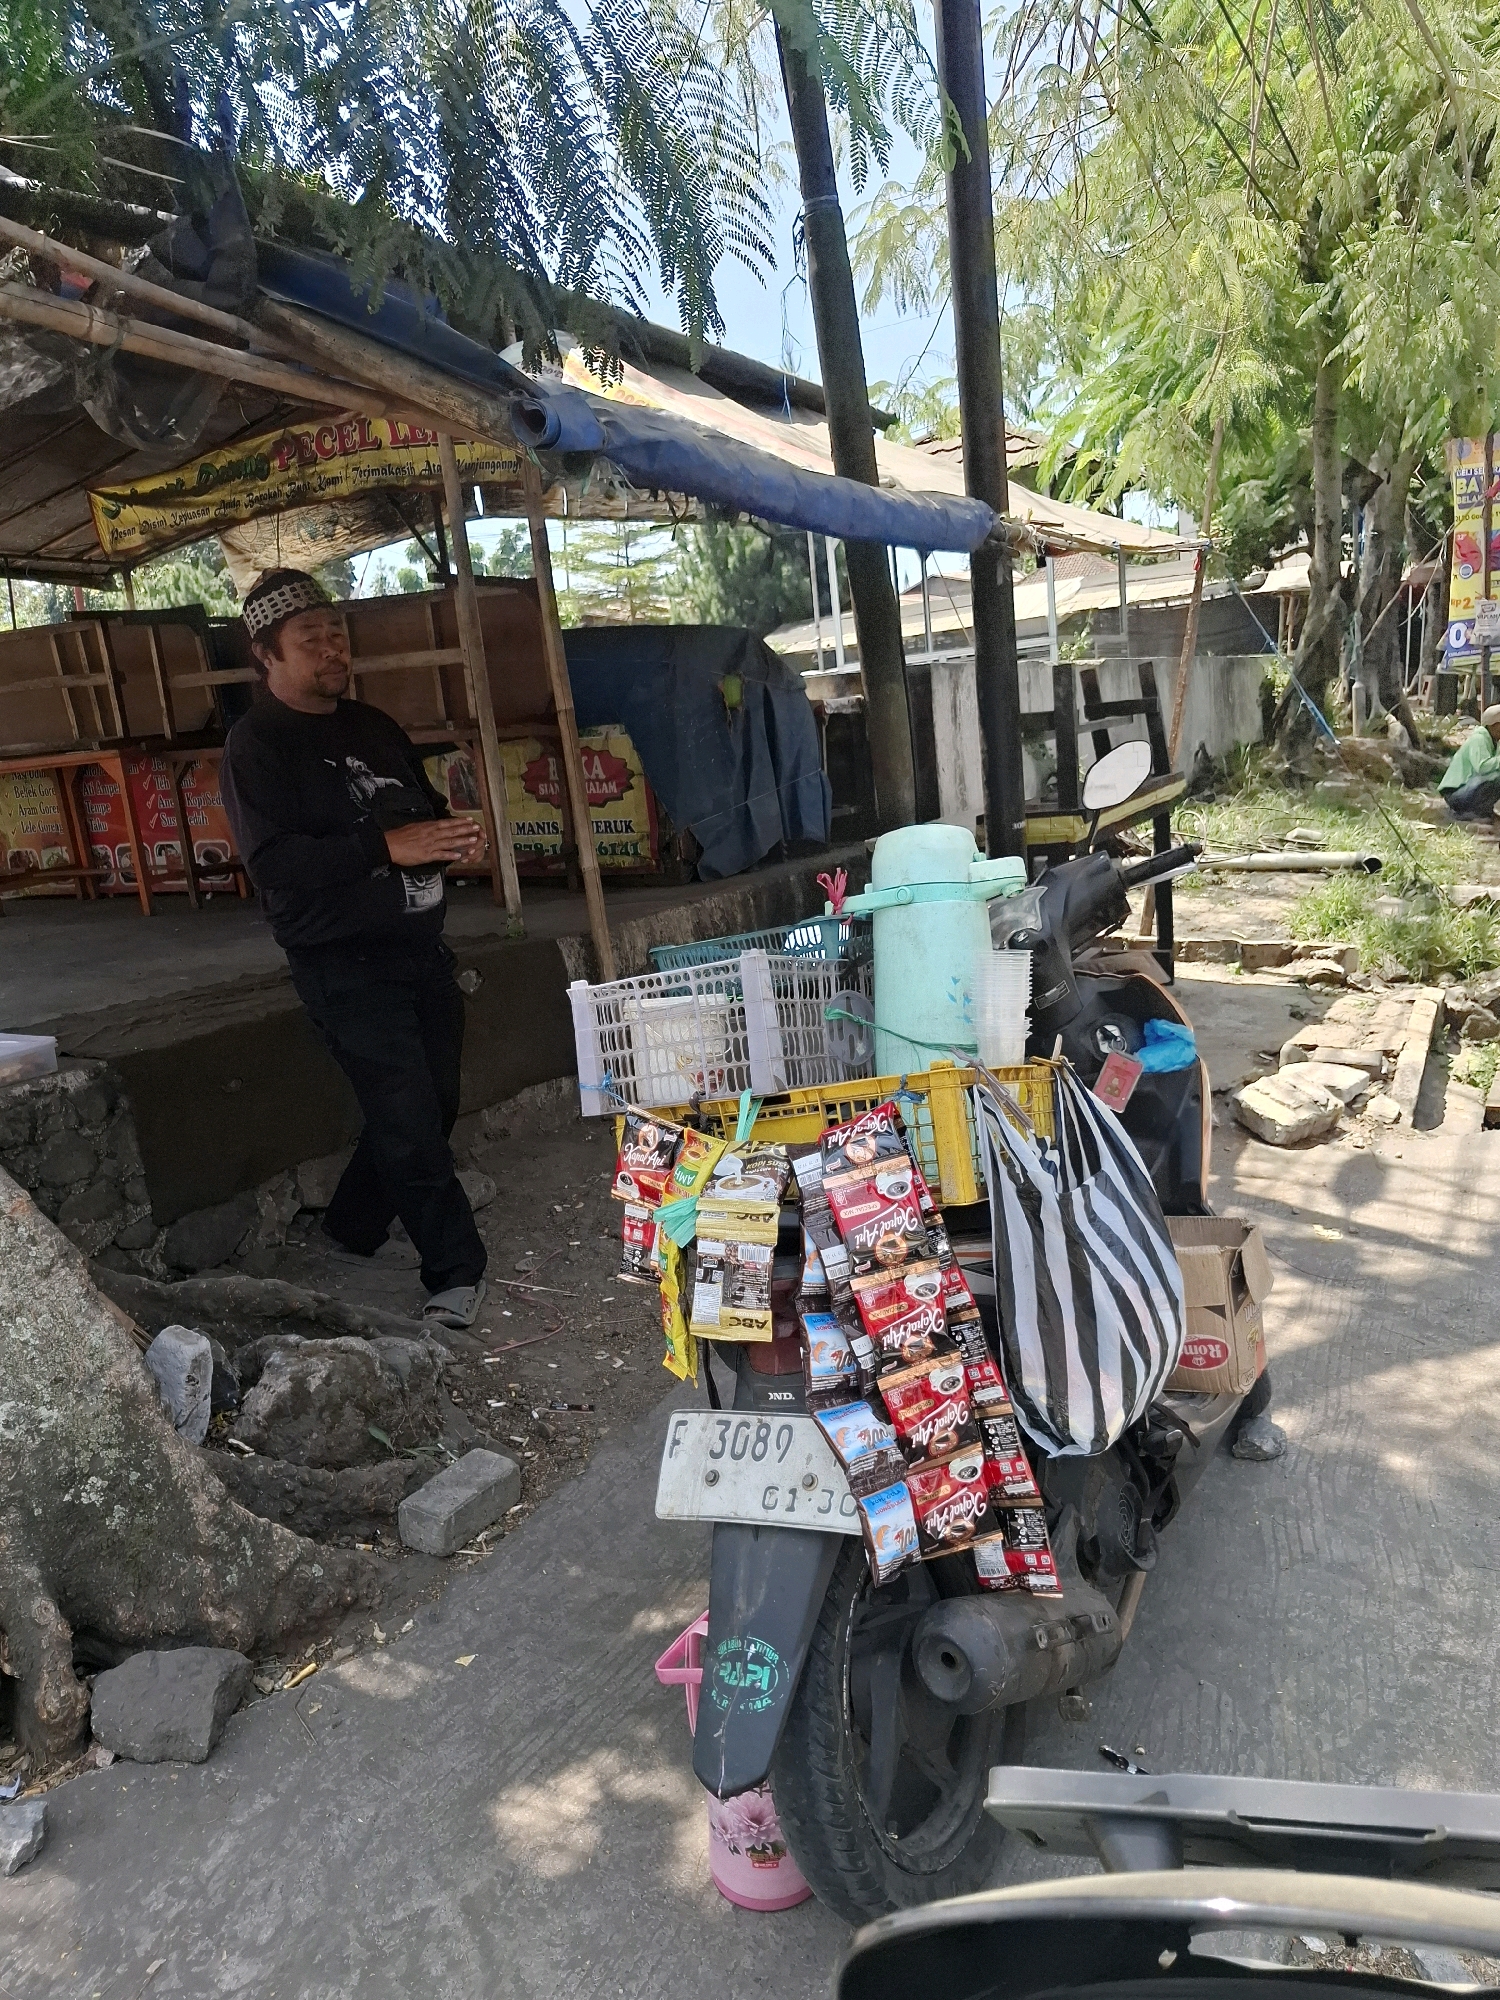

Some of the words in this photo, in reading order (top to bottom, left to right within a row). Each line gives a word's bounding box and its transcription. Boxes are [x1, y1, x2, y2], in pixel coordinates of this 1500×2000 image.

[271, 417, 382, 472] PECEL
[420, 459, 443, 477] Ata
[169, 506, 211, 529] Kepuasan
[213, 497, 241, 517] Anda
[243, 489, 283, 510] Barokah
[315, 474, 344, 494] Kami
[38, 782, 57, 797] Gore
[153, 776, 171, 790] Teh
[538, 782, 561, 796] SIAN
[586, 780, 618, 795] ALAM
[85, 801, 112, 816] Tempe
[186, 793, 206, 807] Kopi
[18, 804, 38, 818] Ayam
[20, 821, 37, 834] Lele
[90, 818, 109, 832] Tahu
[160, 813, 177, 828] Sus
[188, 814, 209, 828] eduh
[515, 820, 560, 835] MANIS
[827, 1128, 853, 1149] Api
[623, 1143, 650, 1167] Kapal
[647, 1150, 668, 1167] Api
[746, 1160, 766, 1170] KOPI
[766, 1160, 790, 1170] SUSU
[855, 1203, 878, 1214] SPECIAL
[879, 1206, 918, 1240] Kapal
[854, 1225, 880, 1249] Api
[728, 1316, 769, 1330] ABC
[905, 1307, 945, 1338] Kapal
[881, 1322, 907, 1351] Api
[1184, 1344, 1222, 1359] Rom
[934, 1400, 969, 1433] Kapal
[668, 1419, 689, 1459] F
[708, 1419, 794, 1464] 3089
[910, 1420, 936, 1449] Api
[948, 1491, 987, 1523] Kapal
[925, 1505, 950, 1535] Api
